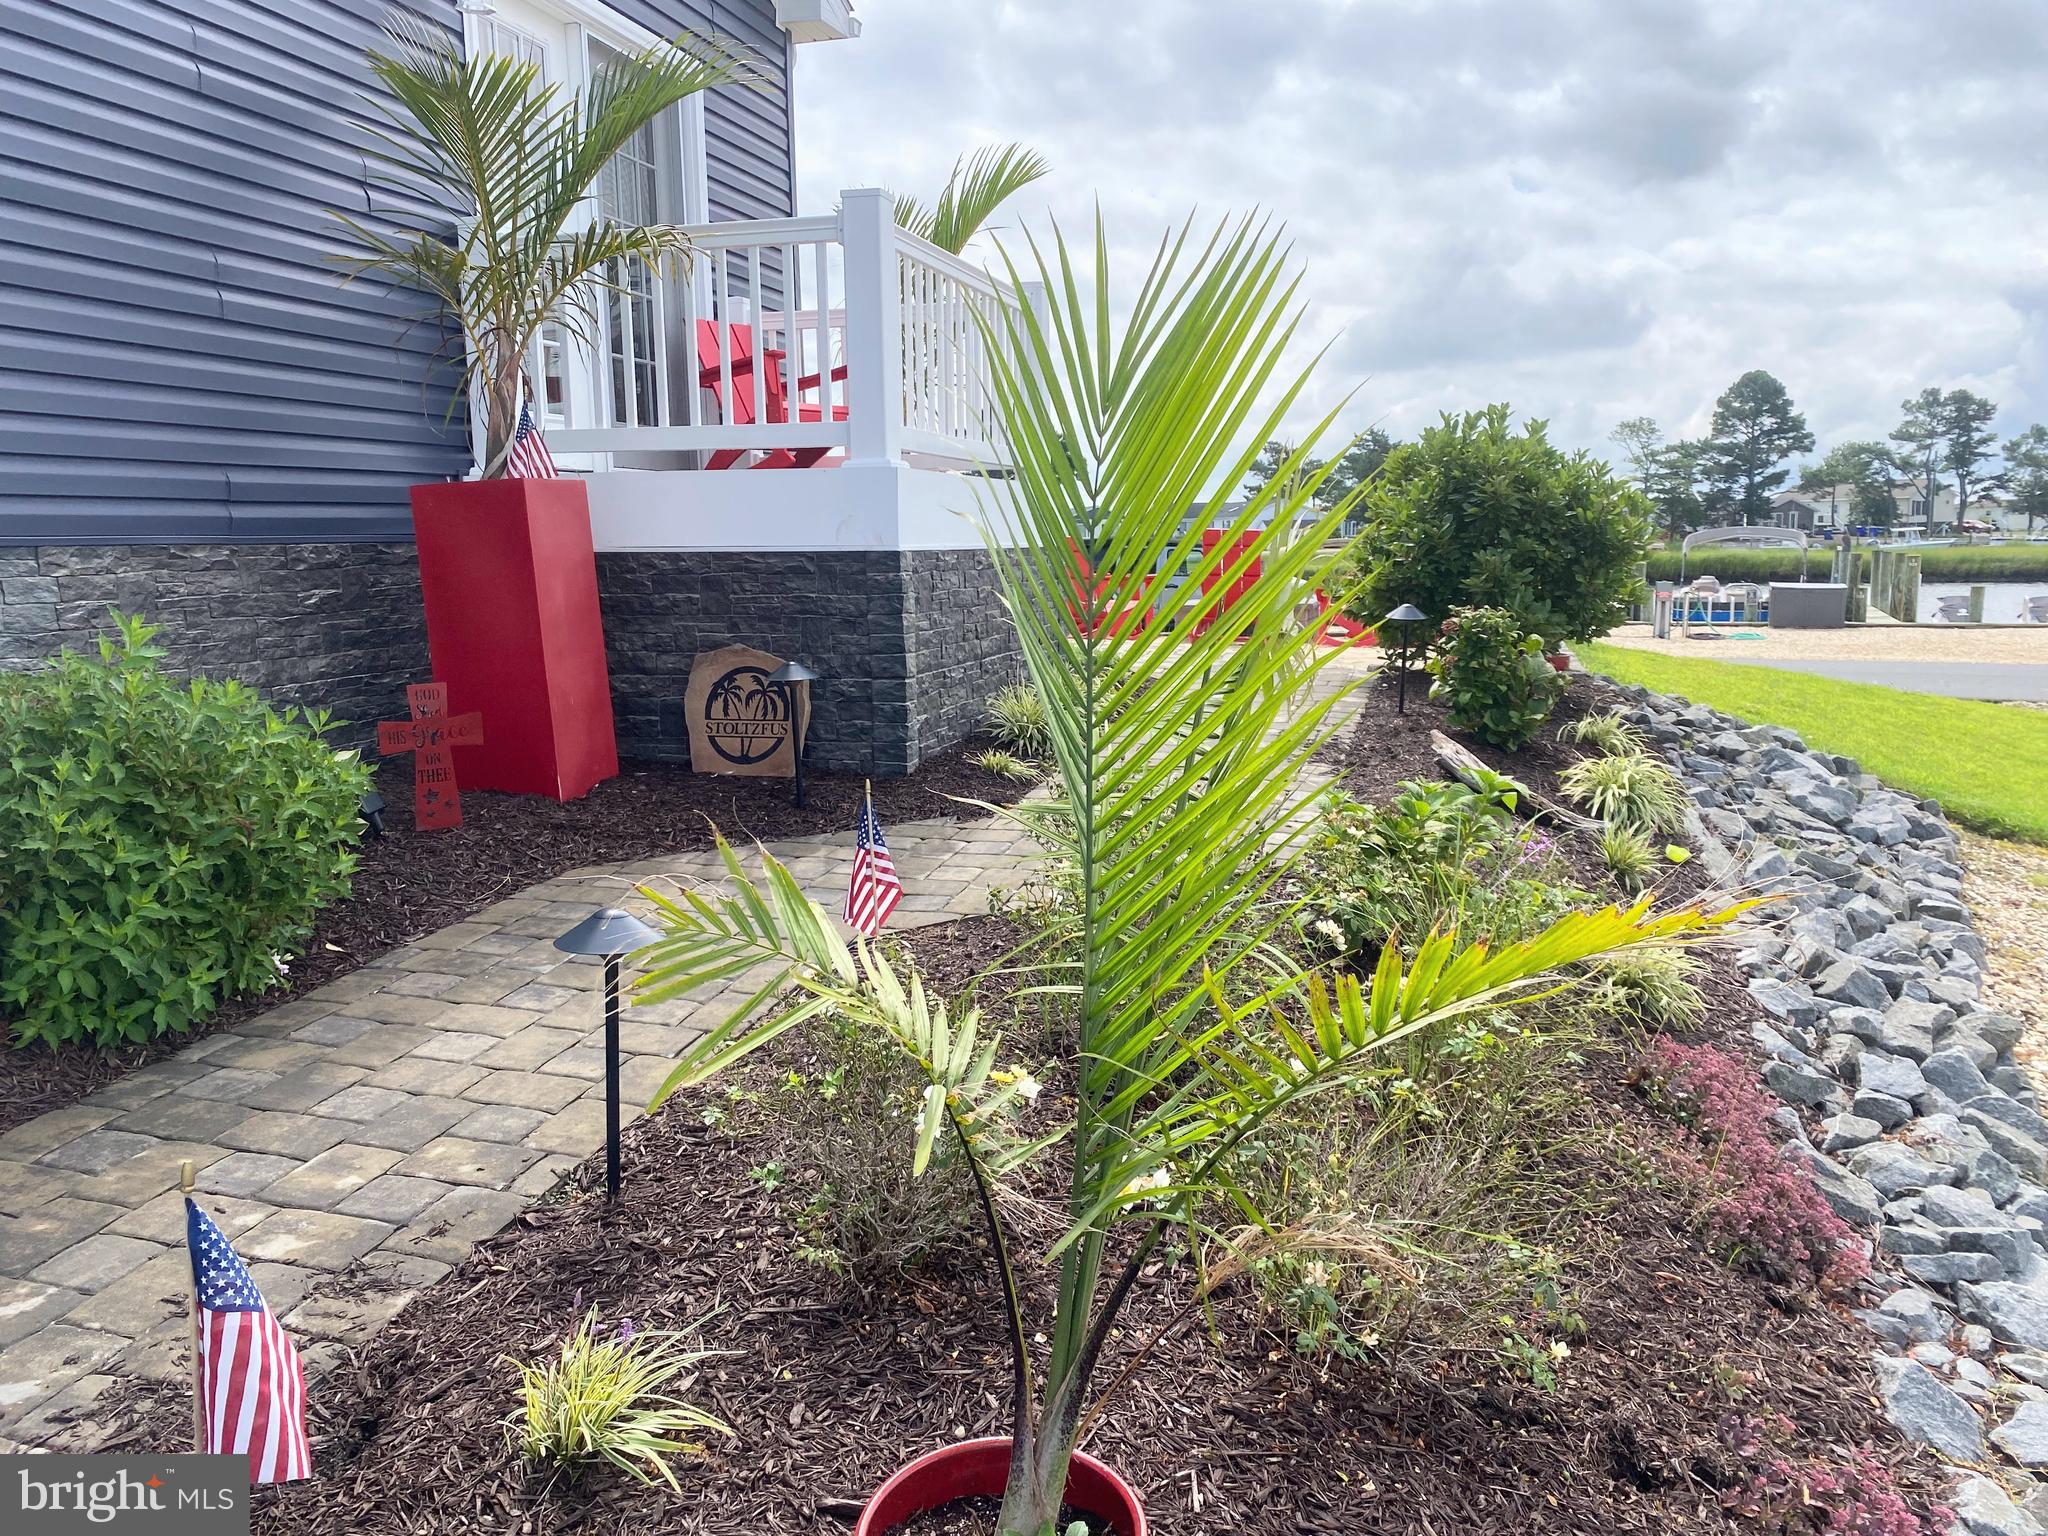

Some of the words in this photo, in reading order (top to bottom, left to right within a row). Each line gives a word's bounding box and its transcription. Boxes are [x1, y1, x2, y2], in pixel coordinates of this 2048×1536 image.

[415, 689, 440, 700] GOD
[387, 730, 407, 745] HIS
[411, 723, 469, 748] Grace
[705, 721, 788, 736] STOLTZFUS
[426, 753, 442, 765] ON
[417, 767, 451, 784] THEE
